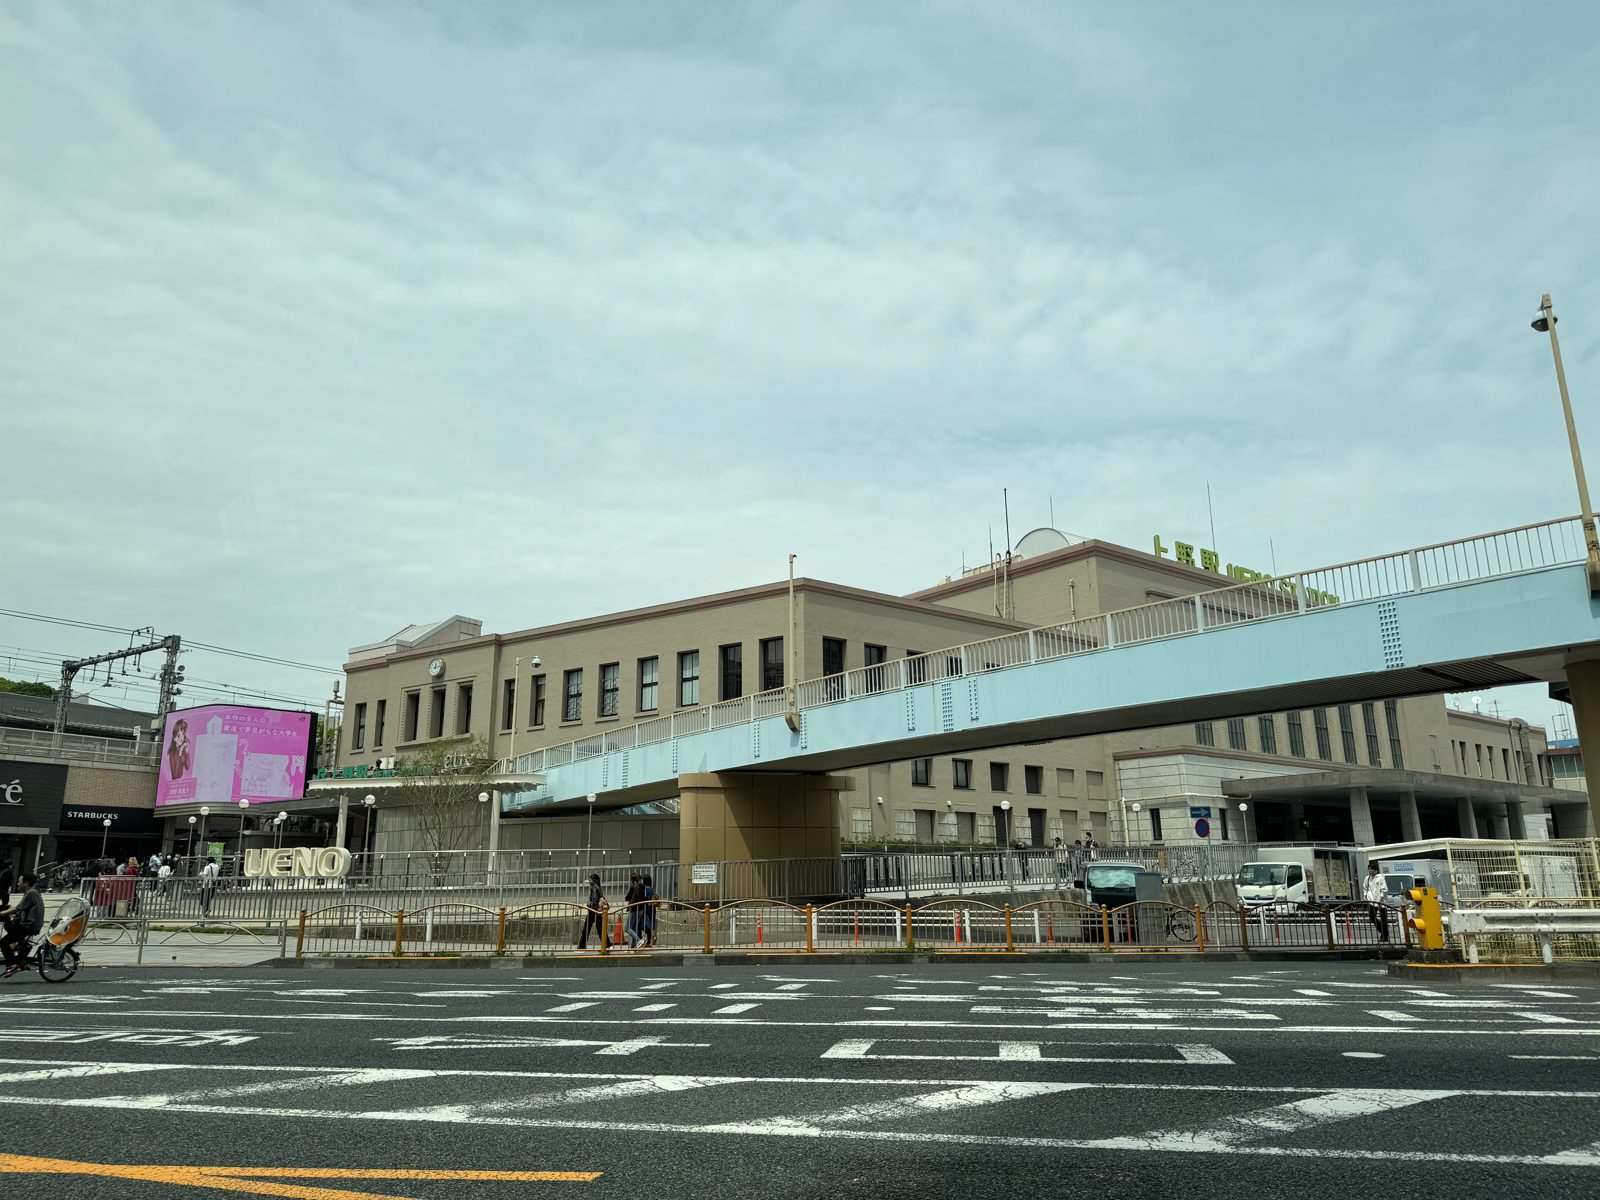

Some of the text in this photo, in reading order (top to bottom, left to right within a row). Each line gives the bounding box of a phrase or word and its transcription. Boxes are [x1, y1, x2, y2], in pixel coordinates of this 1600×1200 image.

[1153, 534, 1219, 574] 上野駅
[67, 811, 119, 820] STARBUCKS
[243, 846, 352, 878] UENO
[1456, 874, 1477, 886] CNG
